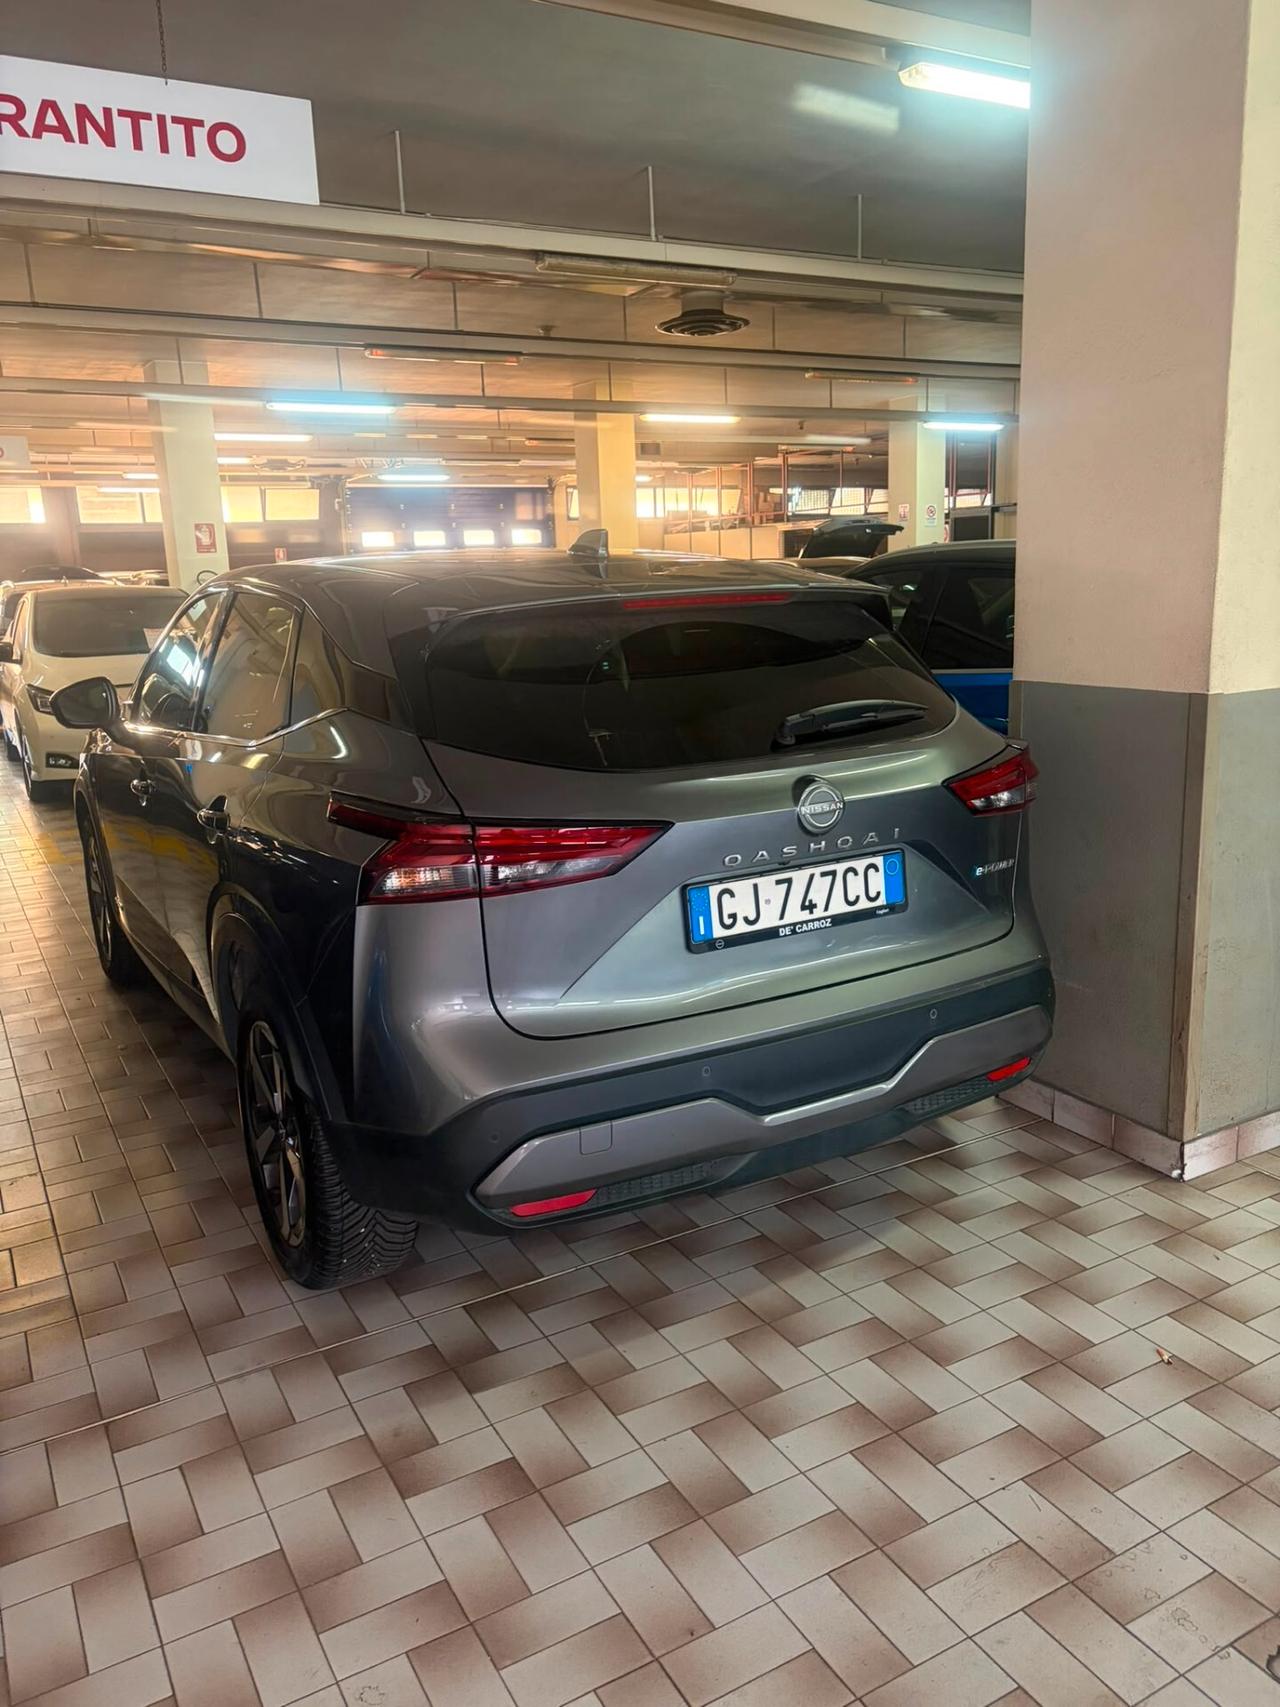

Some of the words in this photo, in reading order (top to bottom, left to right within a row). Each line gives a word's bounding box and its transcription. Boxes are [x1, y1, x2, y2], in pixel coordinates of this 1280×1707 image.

[0, 93, 247, 163] RANTITO
[800, 801, 843, 815] NISSAN
[796, 918, 832, 933] CARROZ
